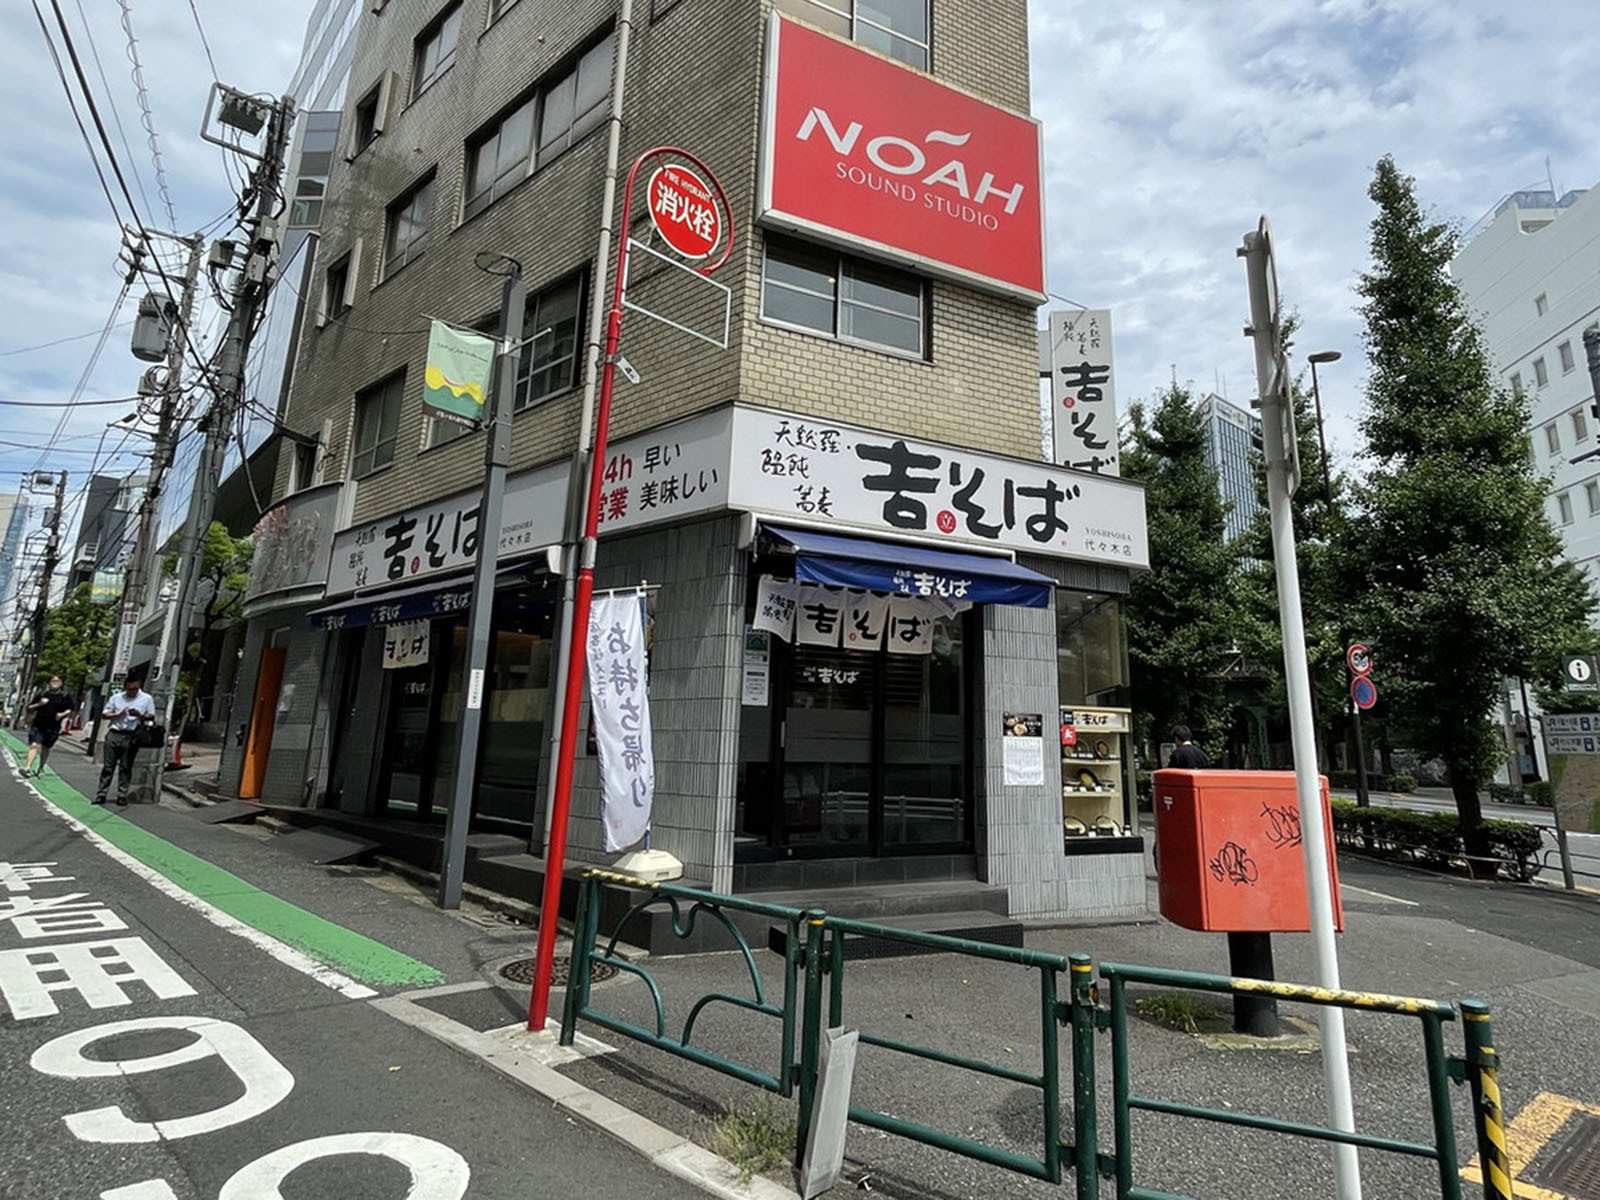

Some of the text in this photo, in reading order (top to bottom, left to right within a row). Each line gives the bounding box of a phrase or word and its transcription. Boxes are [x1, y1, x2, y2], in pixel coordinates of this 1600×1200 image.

[796, 106, 1024, 215] NOAH
[655, 181, 715, 242] 消火栓
[836, 162, 999, 231] SOUND STUDIO
[601, 453, 633, 484] 4h
[642, 443, 681, 474] 早い
[640, 469, 718, 511] 美味しい
[856, 441, 1080, 542] 吉そば
[1085, 538, 1132, 556] 代々木店
[913, 572, 972, 597] 吉そば
[803, 604, 930, 642] 吉そば
[817, 667, 860, 685] 吉そば
